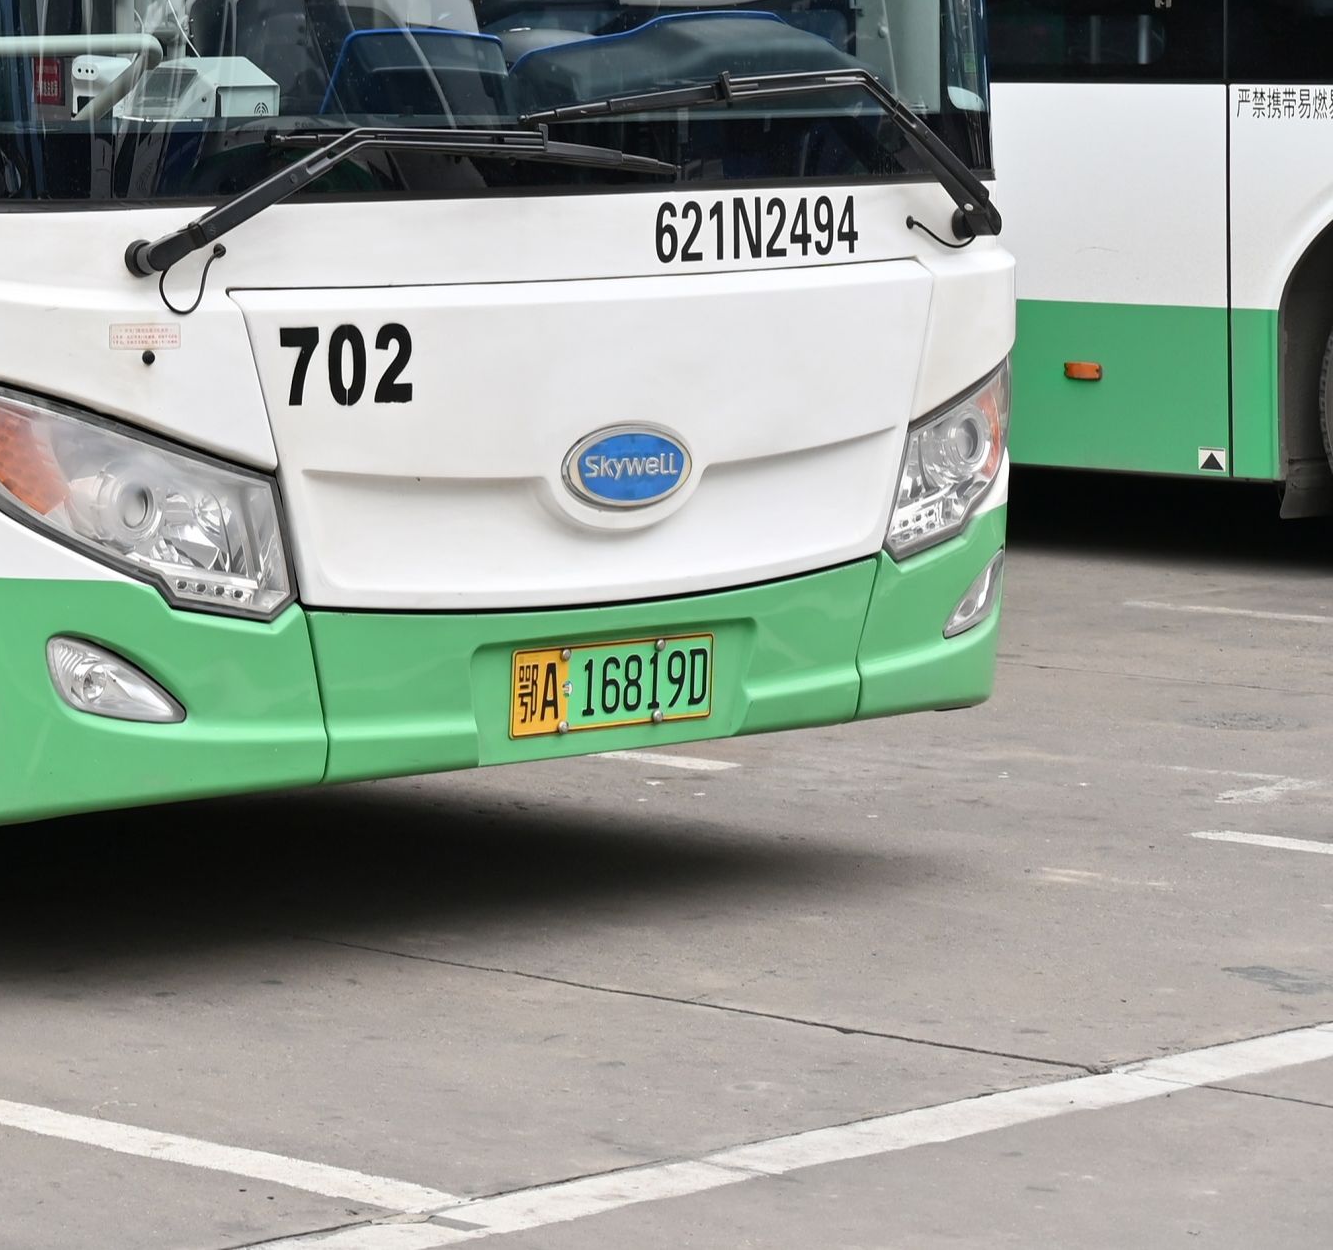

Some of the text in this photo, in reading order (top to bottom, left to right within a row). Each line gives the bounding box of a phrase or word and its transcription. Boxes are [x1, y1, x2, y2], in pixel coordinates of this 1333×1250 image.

[655, 194, 859, 264] 621N2494
[279, 322, 414, 407] 702
[584, 452, 679, 481] Skywell
[518, 647, 709, 724] 鄂A 16819D
